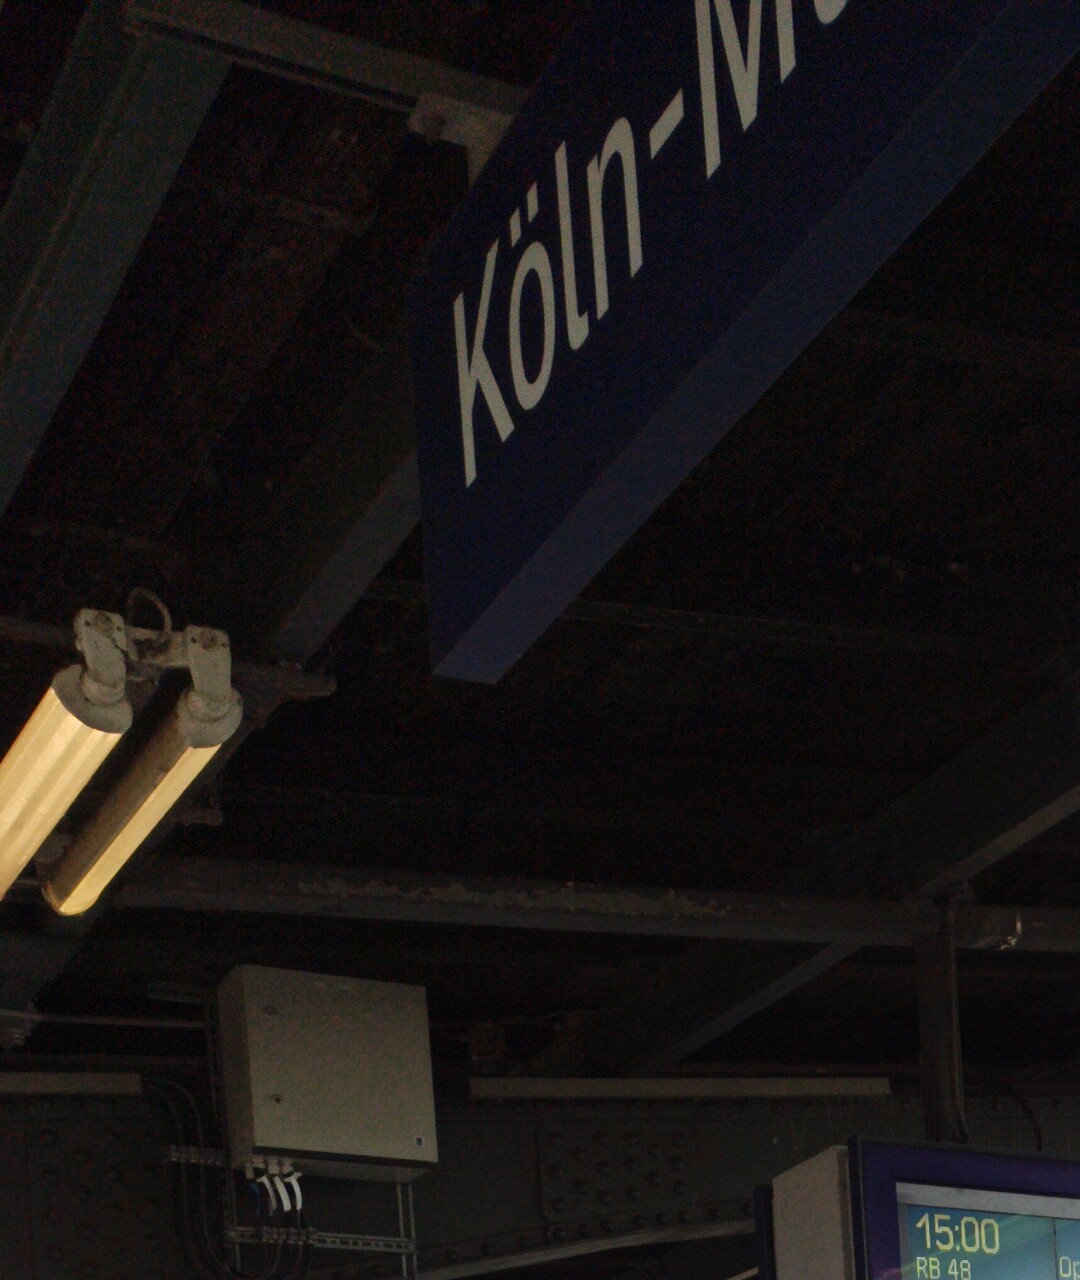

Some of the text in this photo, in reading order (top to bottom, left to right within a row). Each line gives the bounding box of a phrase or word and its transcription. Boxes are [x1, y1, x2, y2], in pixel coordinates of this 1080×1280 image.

[452, 0, 850, 489] Köln-M
[915, 1212, 1000, 1255] 15:00
[915, 1256, 940, 1280] RB
